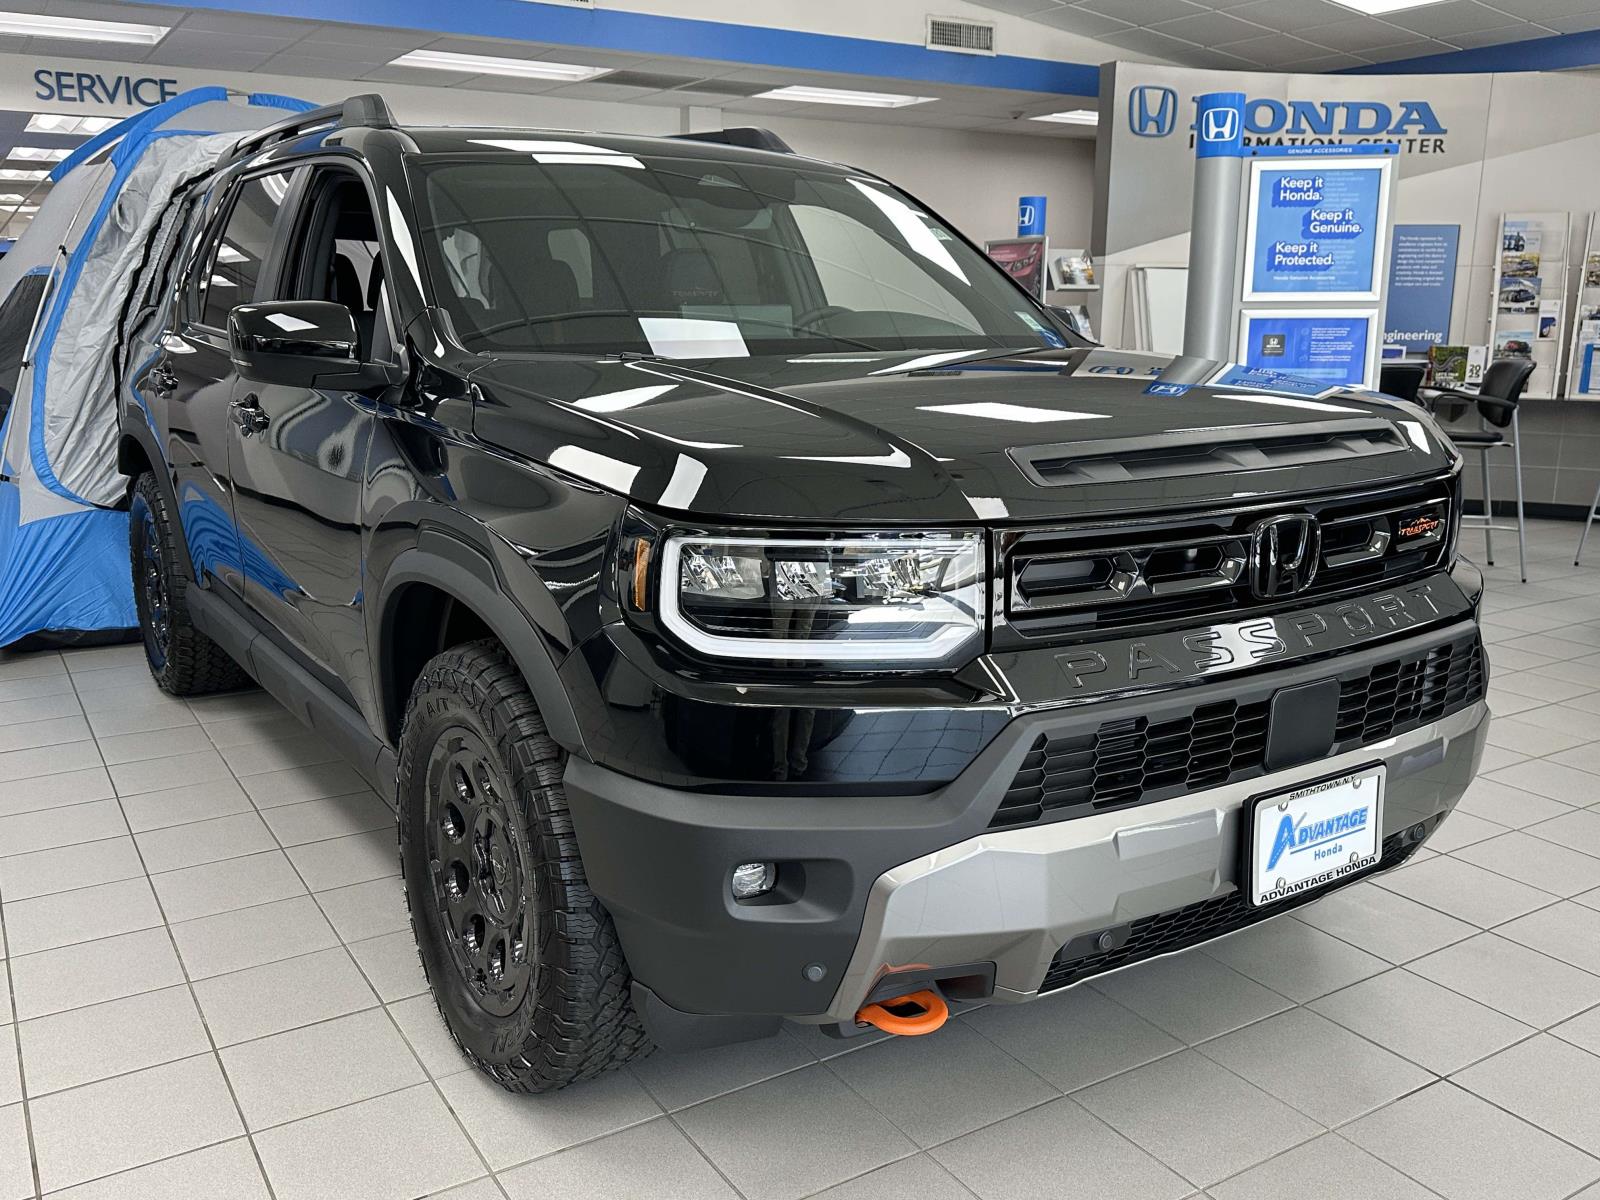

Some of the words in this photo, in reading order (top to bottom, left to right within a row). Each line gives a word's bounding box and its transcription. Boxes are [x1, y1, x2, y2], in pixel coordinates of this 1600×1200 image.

[34, 69, 177, 107] SERVICE
[1189, 98, 1448, 135] ONDA
[1281, 177, 1312, 191] Keep
[1315, 176, 1324, 188] it
[1280, 190, 1323, 201] Honda.
[1310, 209, 1342, 223] Keep
[1345, 208, 1354, 220] it
[1309, 221, 1363, 233] Genuine.
[1275, 242, 1307, 256] Keep
[1309, 241, 1319, 253] it
[1274, 253, 1335, 266] Protected.
[1383, 329, 1443, 343] ngineering
[1054, 583, 1441, 689] PASSPORT
[1265, 806, 1369, 872] ADVANTAGE
[1314, 843, 1343, 861] Honda
[1260, 871, 1334, 904] ADVANTAGE
[1335, 856, 1377, 877] HONDA
